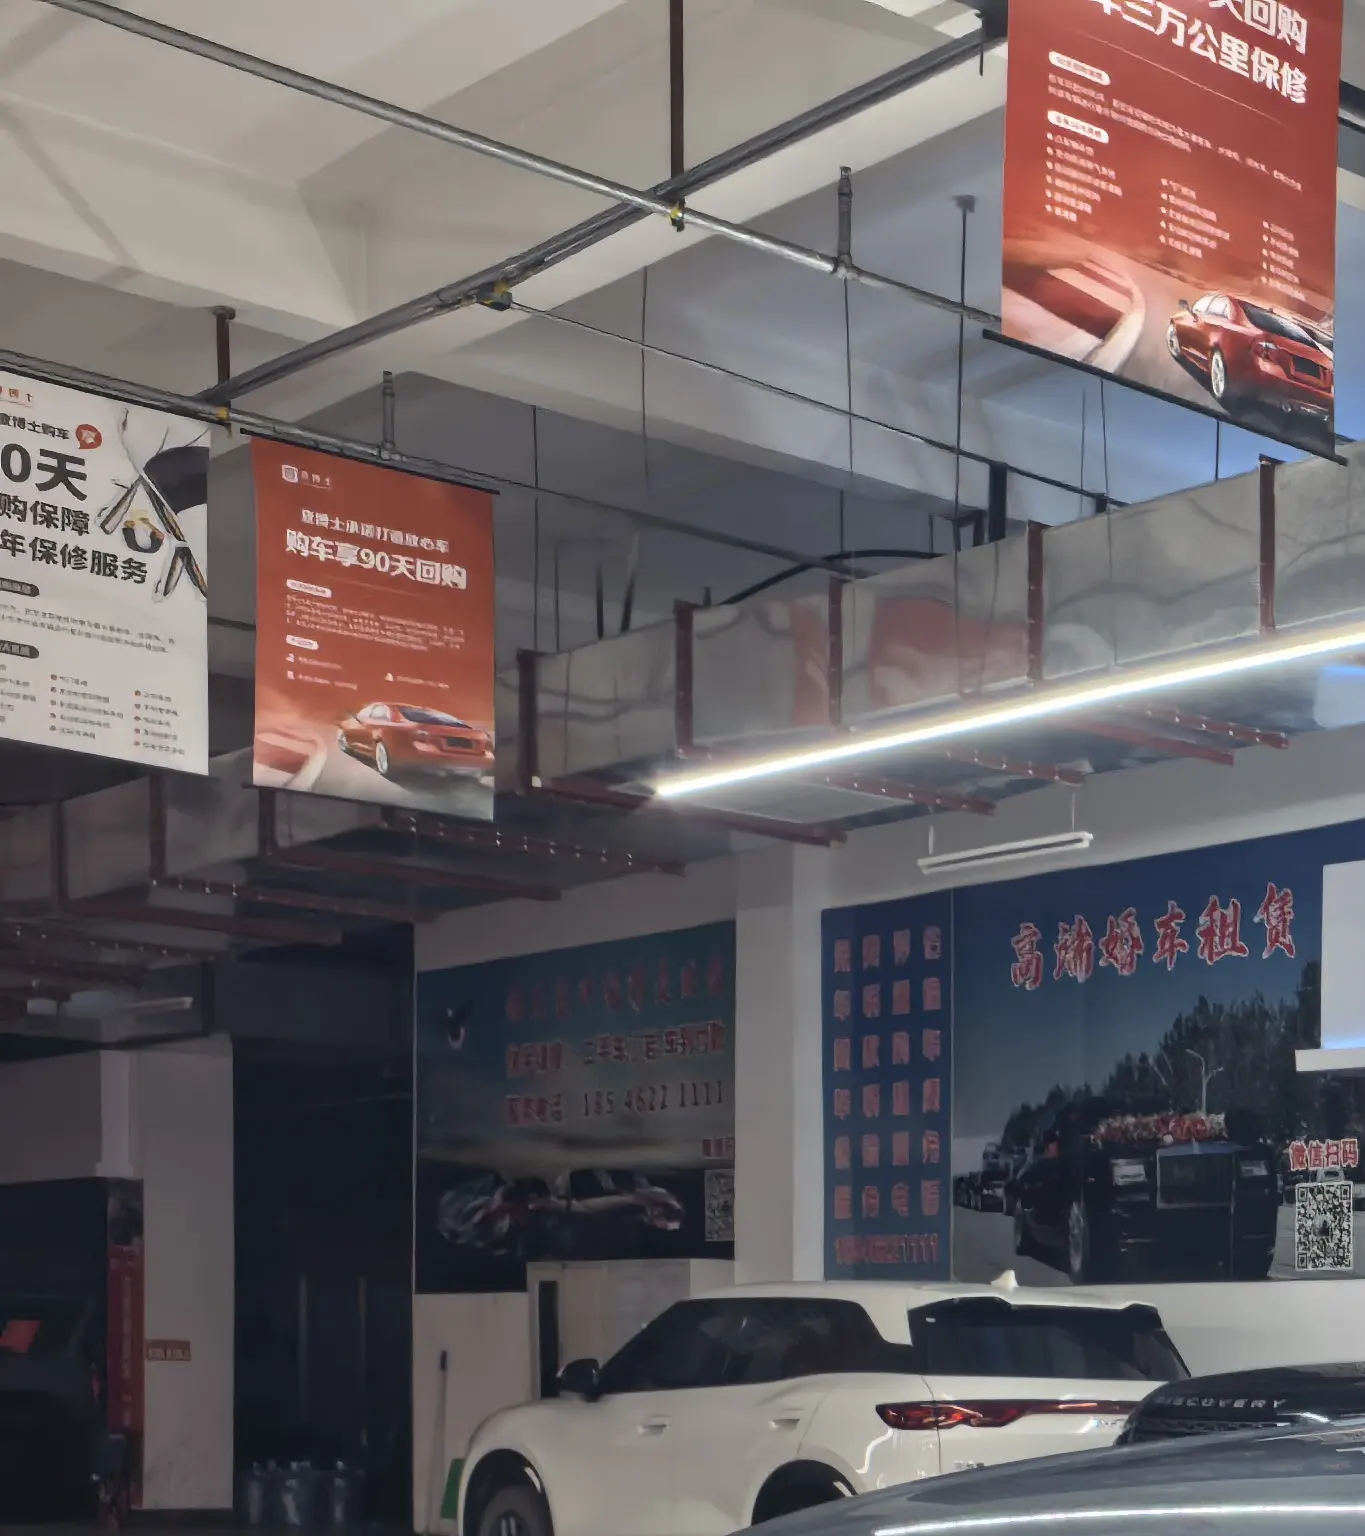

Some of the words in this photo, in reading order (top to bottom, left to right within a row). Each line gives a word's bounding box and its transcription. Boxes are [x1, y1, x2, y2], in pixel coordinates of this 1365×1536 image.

[1, 443, 88, 501] 0天
[286, 528, 467, 590] 购车享90天回购
